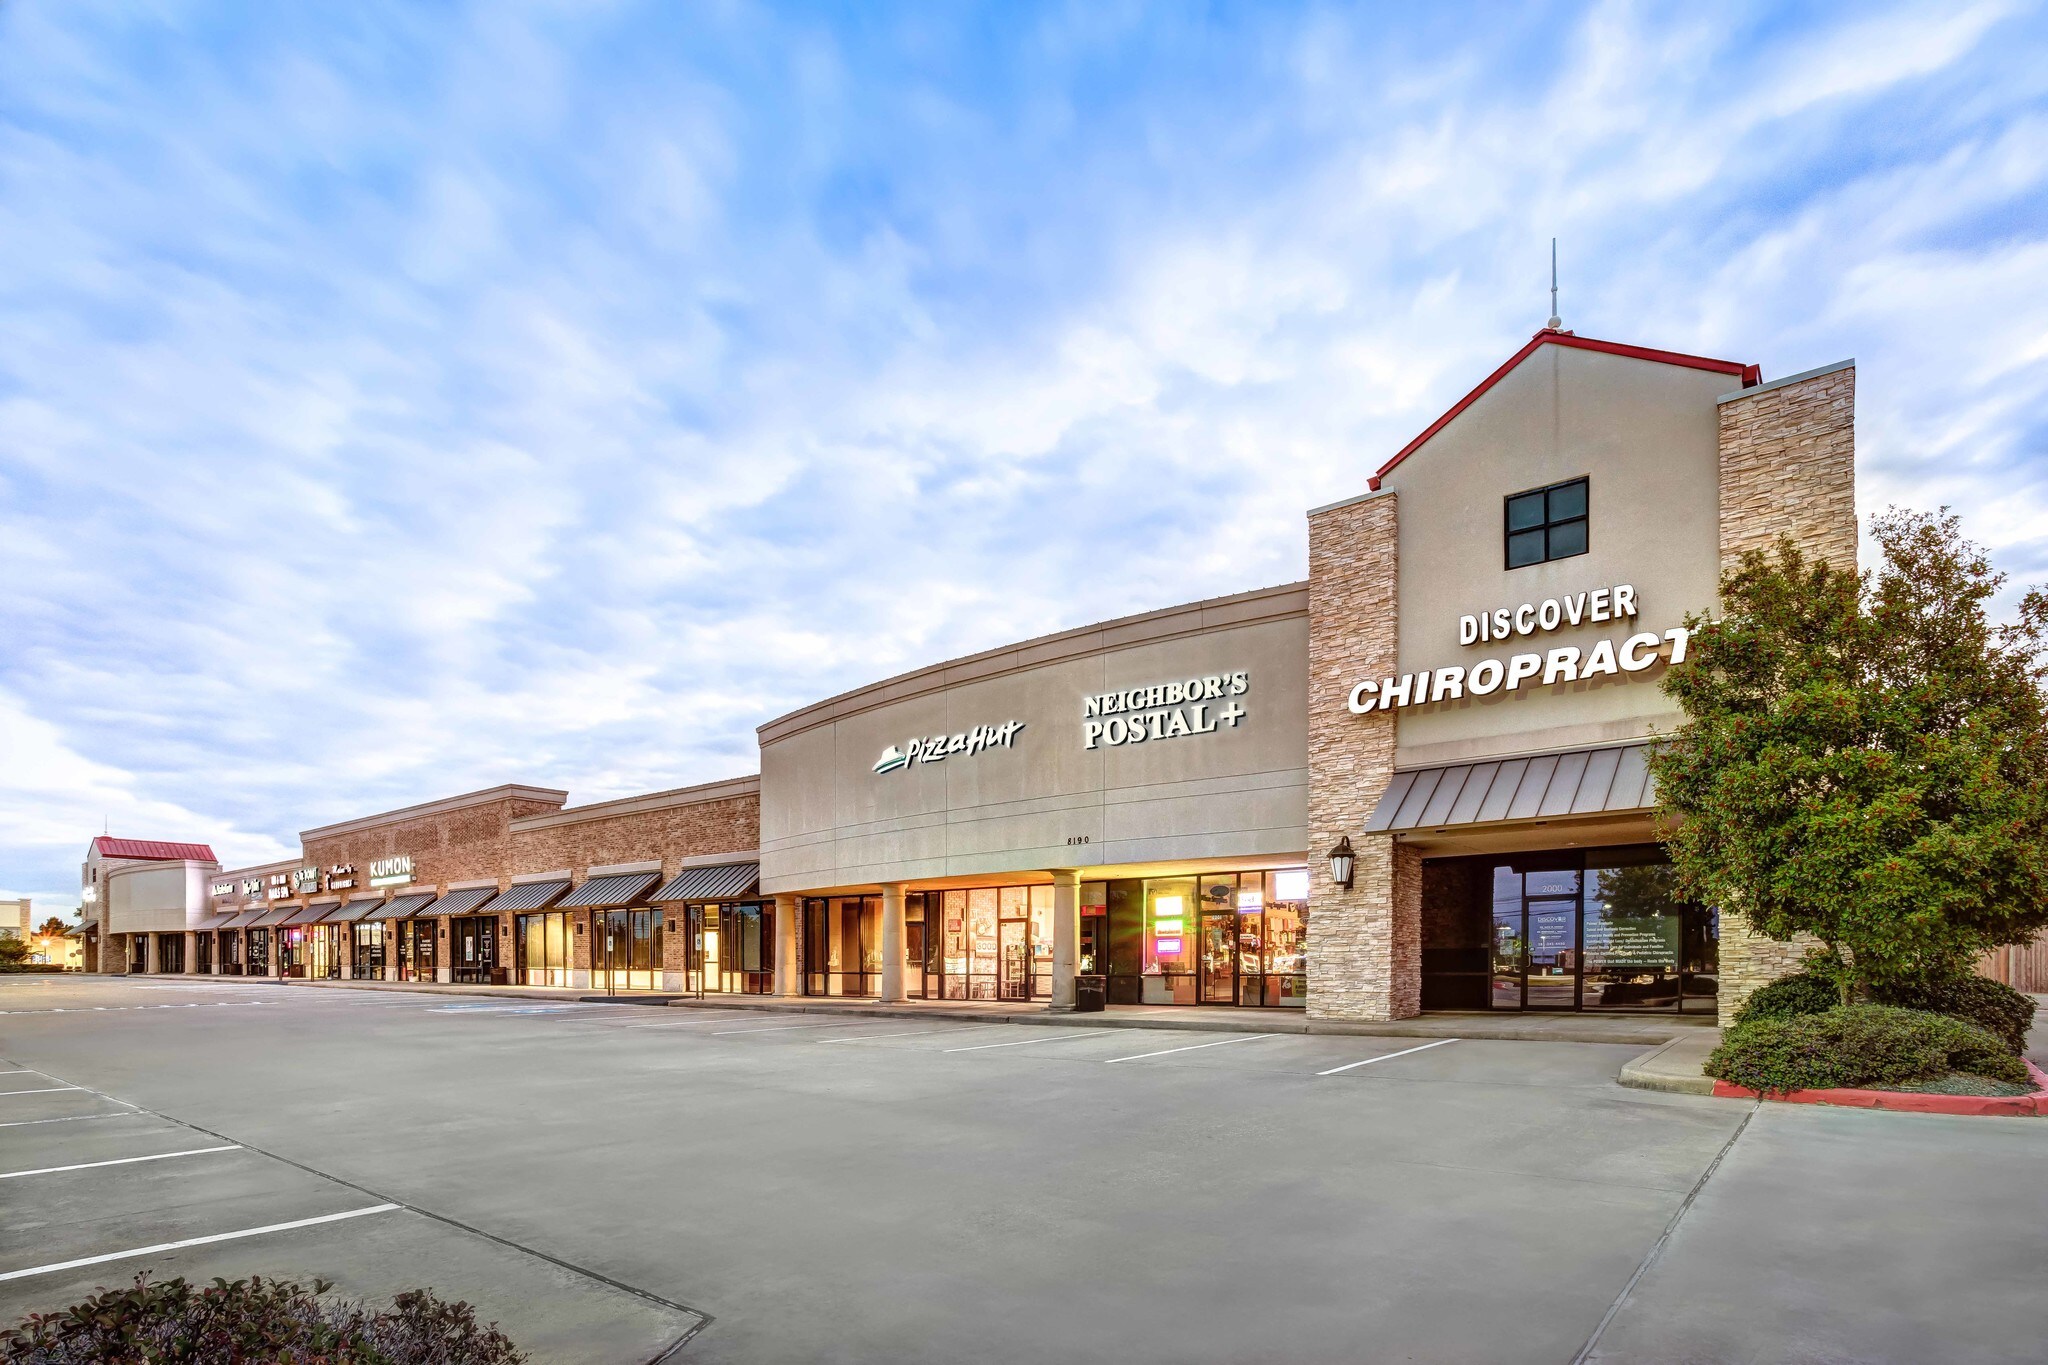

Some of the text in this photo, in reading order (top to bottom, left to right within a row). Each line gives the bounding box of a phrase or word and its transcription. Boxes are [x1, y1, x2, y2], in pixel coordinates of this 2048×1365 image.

[1460, 584, 1638, 646] DISCOVER
[1348, 621, 1720, 714] CHIROPRACT
[1083, 671, 1248, 717] NEIGHBOR'S
[1067, 836, 1089, 845] 8190
[369, 856, 411, 877] KUMON
[1542, 885, 1563, 893] 2000
